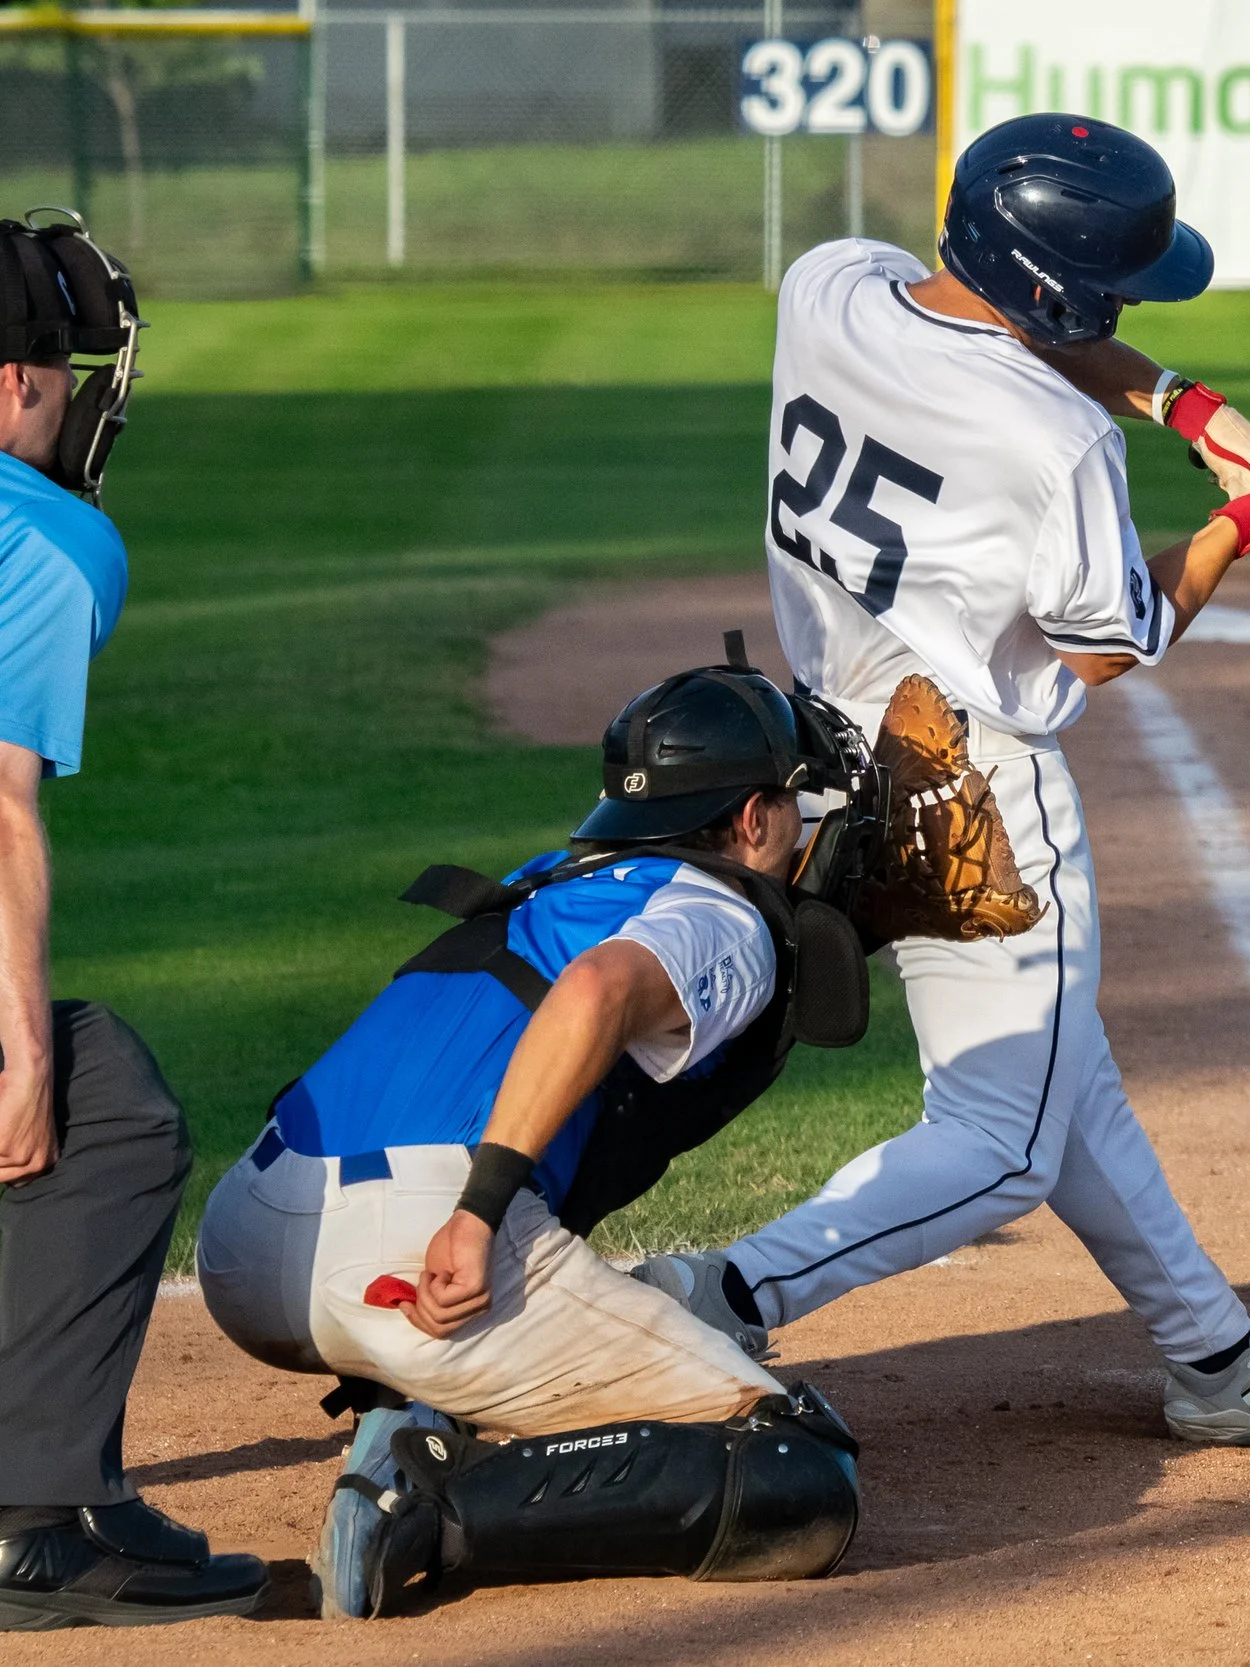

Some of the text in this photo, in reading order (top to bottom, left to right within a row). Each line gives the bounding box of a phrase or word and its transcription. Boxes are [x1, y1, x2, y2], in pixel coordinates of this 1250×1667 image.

[741, 38, 930, 136] 320
[1011, 248, 1064, 293] RAWLINGS
[770, 393, 944, 618] 25
[546, 1432, 628, 1456] FORCE3
